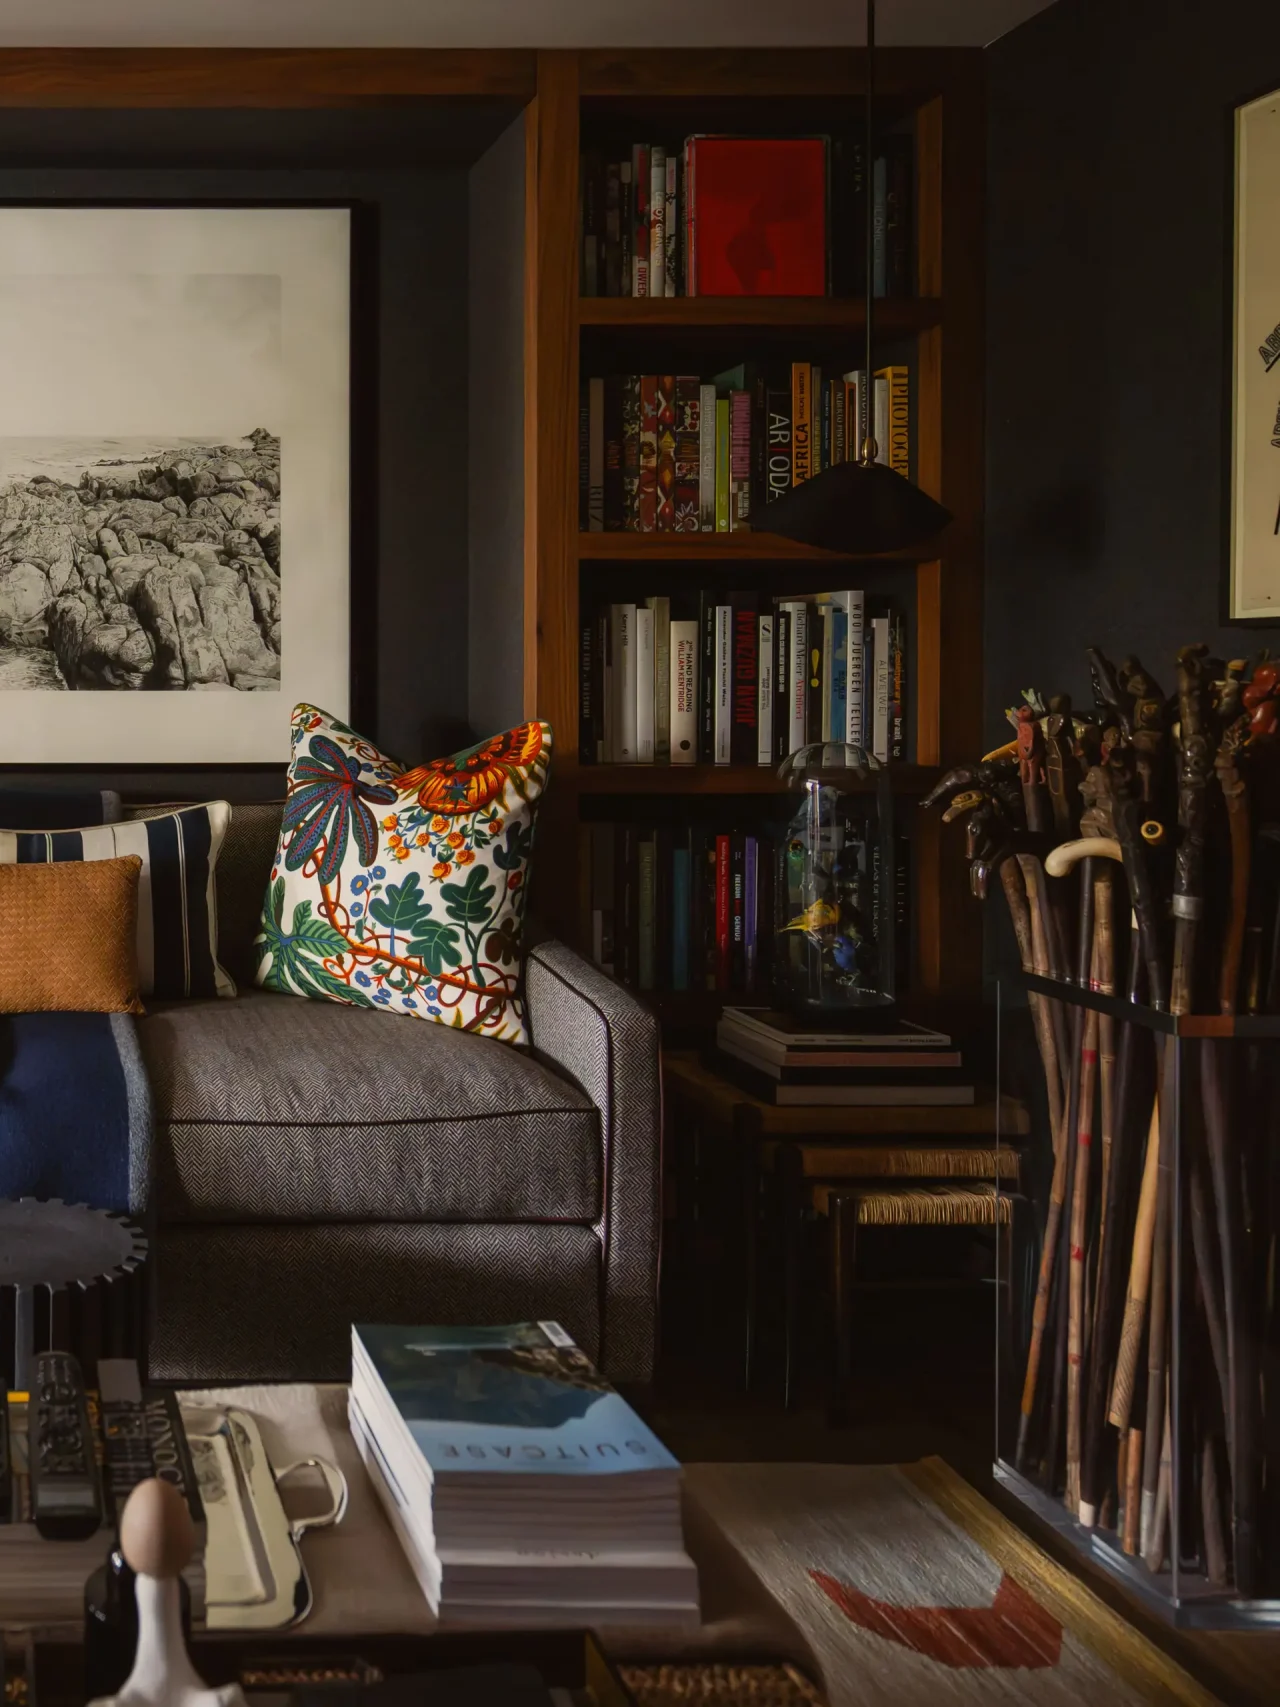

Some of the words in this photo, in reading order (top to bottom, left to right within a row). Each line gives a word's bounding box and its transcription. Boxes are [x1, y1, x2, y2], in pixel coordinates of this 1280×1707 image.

[795, 423, 809, 481] AFRICA
[795, 608, 806, 646] Richard
[677, 640, 686, 671] WILLIAM
[685, 653, 693, 676] HAND
[795, 648, 806, 676] Meier
[851, 641, 861, 694] JUERGEN
[677, 672, 686, 713] KENTRIDGE
[685, 677, 693, 713] READING
[734, 685, 757, 728] JUAN
[795, 678, 806, 720] Architect
[851, 702, 861, 744] TELLER
[438, 1440, 648, 1461] SUITCASE
